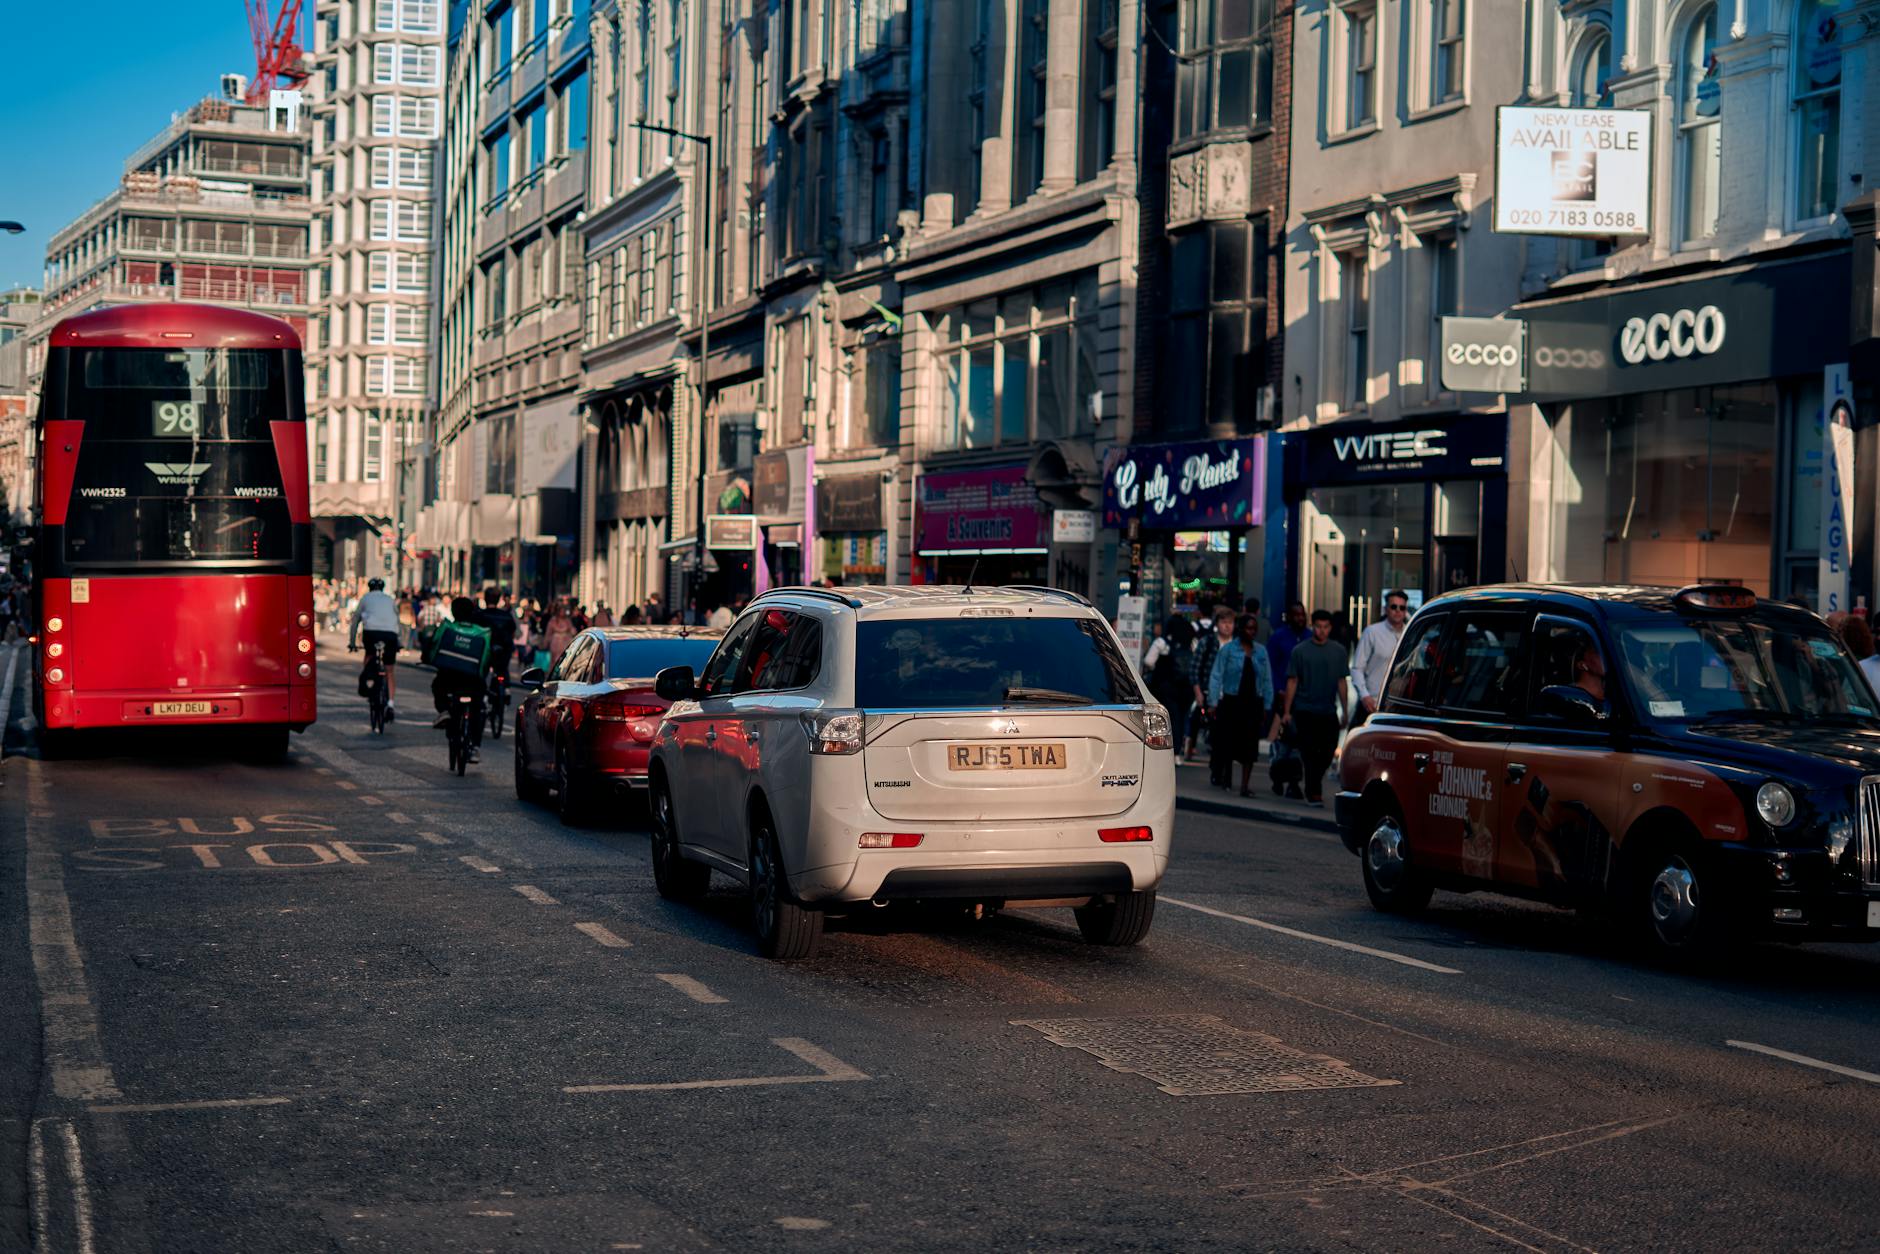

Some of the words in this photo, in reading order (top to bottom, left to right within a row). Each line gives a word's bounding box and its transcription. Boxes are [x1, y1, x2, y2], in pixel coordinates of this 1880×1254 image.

[1533, 113, 1569, 126] NEW
[1574, 114, 1615, 128] LEASE
[1510, 128, 1639, 151] AVAILABLE
[1510, 209, 1542, 225] 020
[1548, 211, 1588, 226] 7183
[1593, 211, 1636, 228] 0588
[1620, 304, 1727, 364] ecco
[1448, 342, 1518, 367] ecco
[158, 402, 197, 433] 98
[157, 476, 201, 485] WRIGHT
[1179, 448, 1241, 495] Planet
[80, 487, 127, 498] VWH2325
[233, 487, 279, 497] VWH2325
[159, 702, 183, 713] LK17
[185, 701, 206, 713] DEU
[956, 745, 1012, 767] RJ65
[1018, 745, 1058, 766] TWA
[1438, 765, 1486, 799] JOHNNIE
[1485, 780, 1493, 801] &
[1428, 792, 1470, 818] LEMONADE
[87, 813, 339, 839] BUS
[72, 840, 417, 872] STOP
